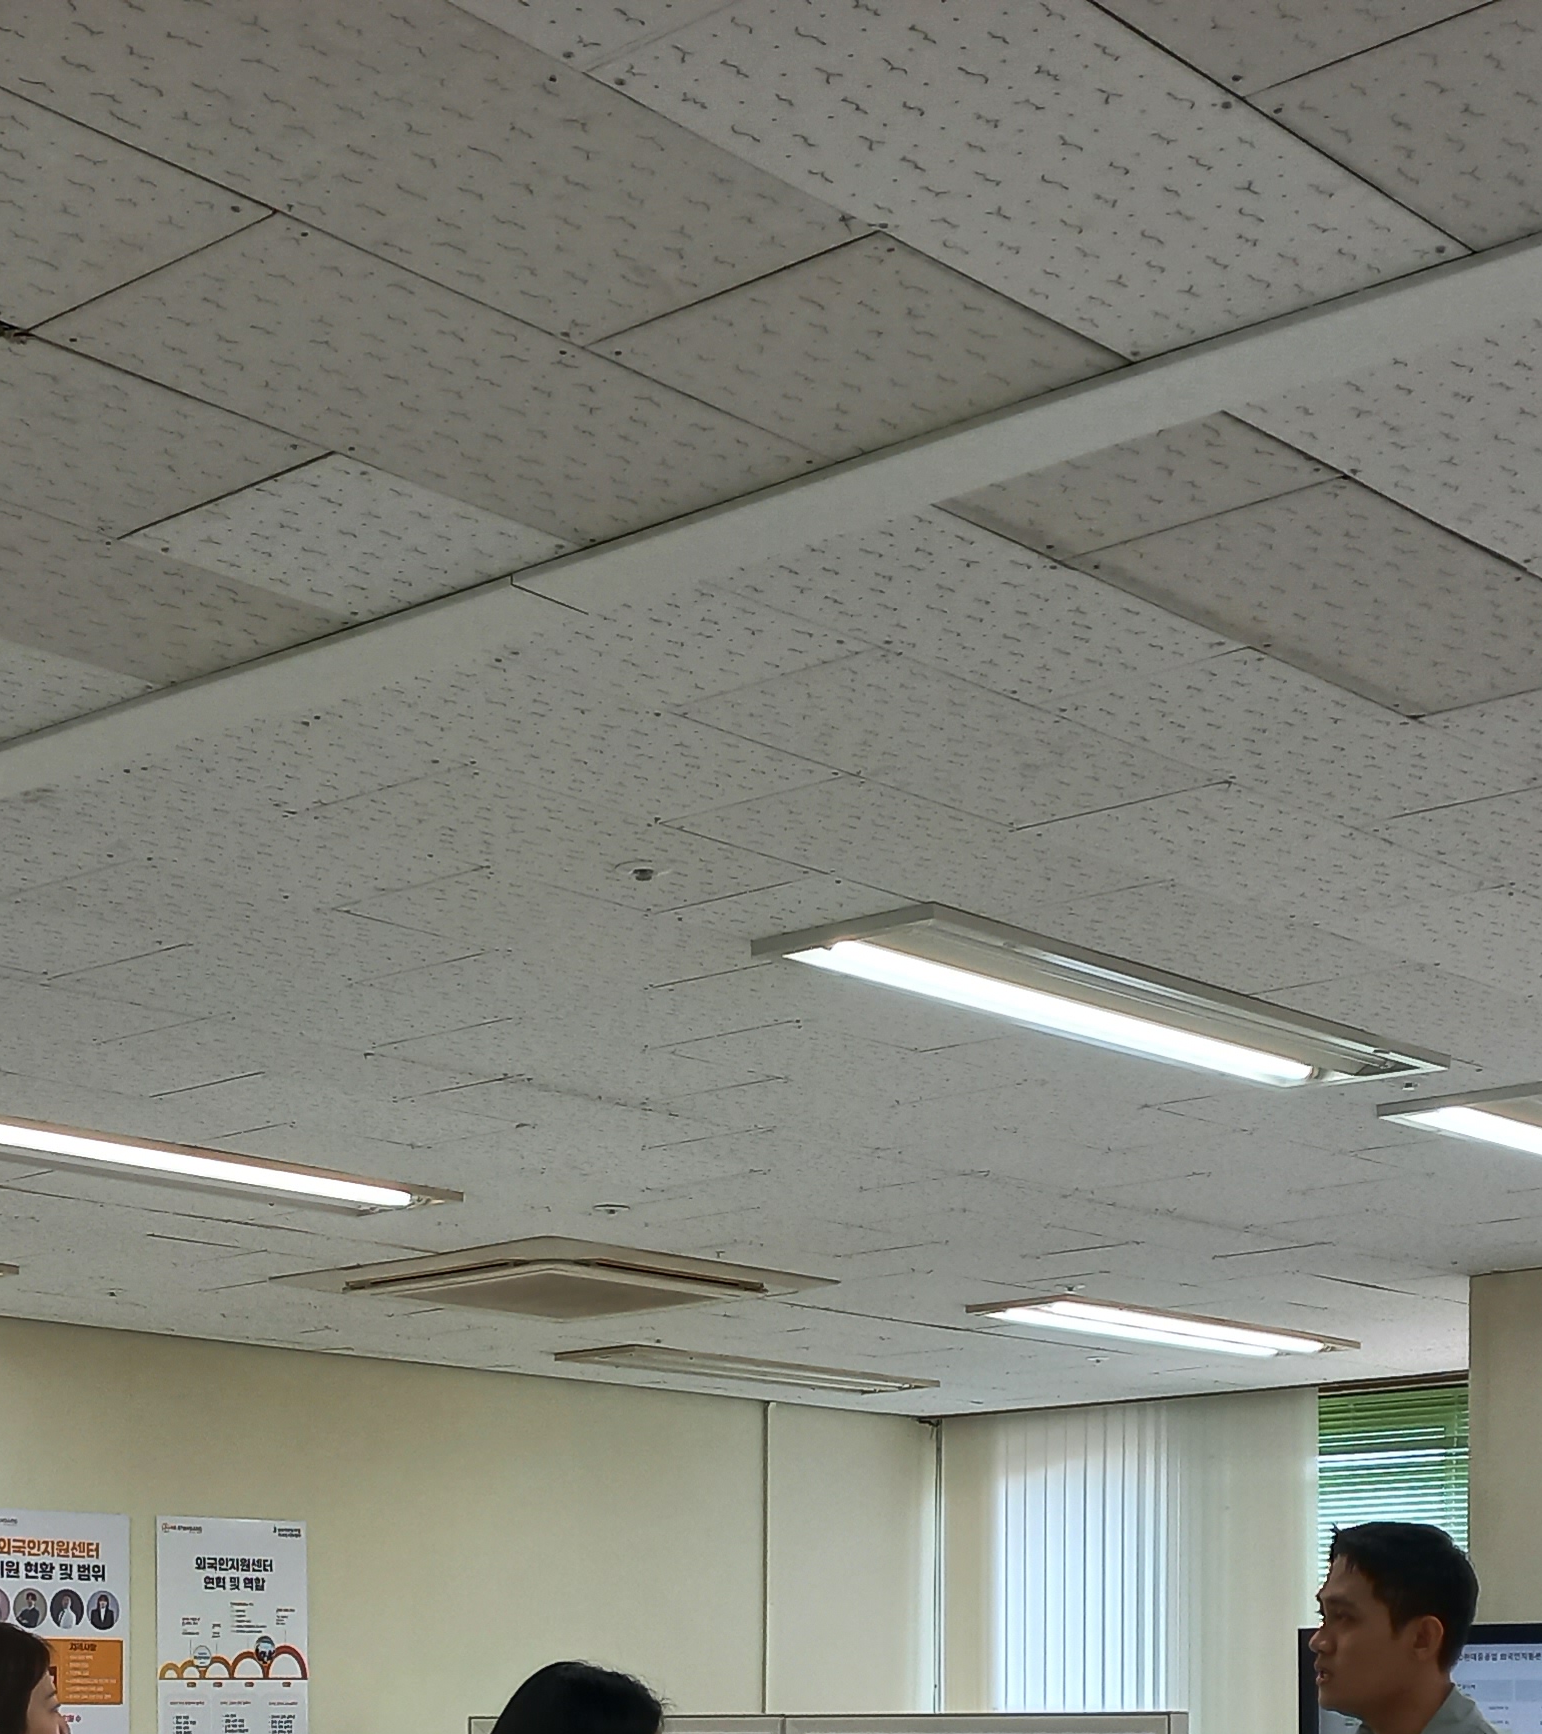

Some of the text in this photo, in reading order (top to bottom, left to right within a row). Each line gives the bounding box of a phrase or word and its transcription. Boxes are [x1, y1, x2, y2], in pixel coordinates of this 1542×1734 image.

[24, 1561, 54, 1580] 현황
[59, 1564, 73, 1581] 및
[77, 1564, 106, 1582] 범위
[195, 1556, 273, 1572] 외국인지원센터
[204, 1576, 266, 1591] 연혁 및 역할
[1460, 1652, 1498, 1661] 현대중공업
